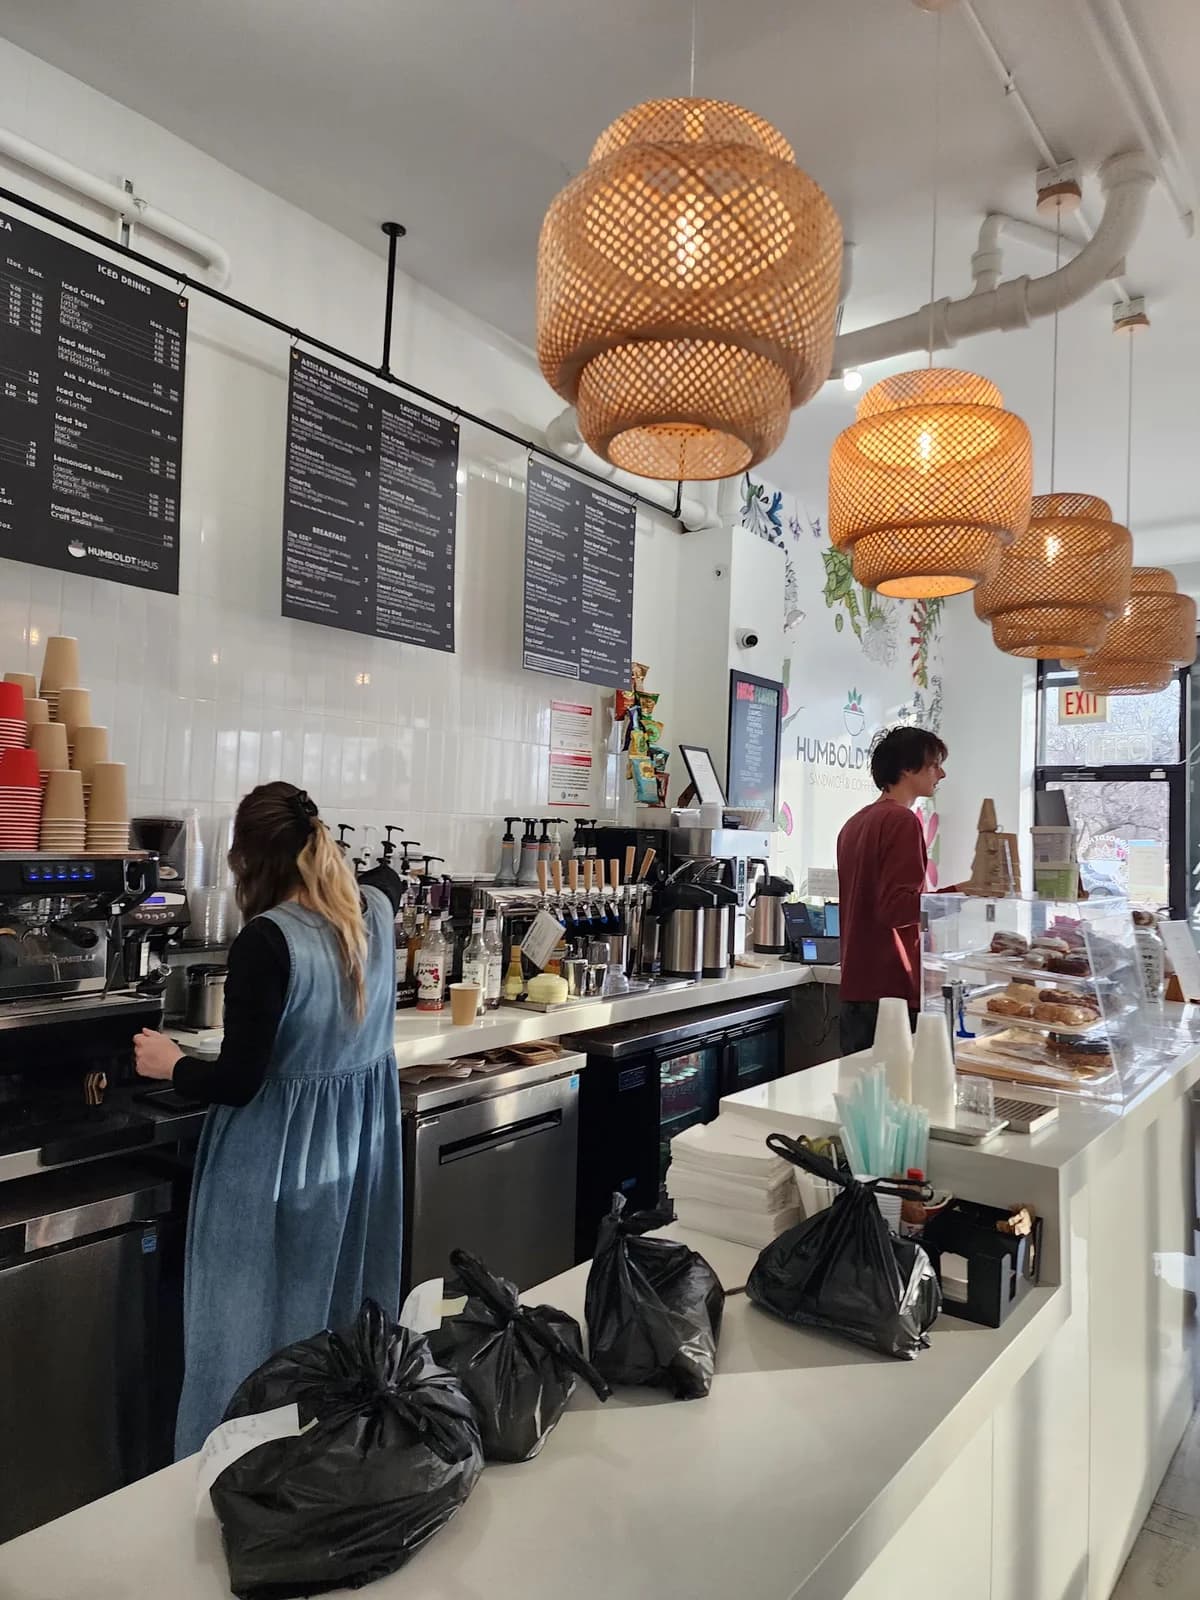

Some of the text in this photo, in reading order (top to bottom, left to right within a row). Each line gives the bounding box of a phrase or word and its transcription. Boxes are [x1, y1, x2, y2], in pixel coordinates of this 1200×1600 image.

[98, 264, 151, 295] ICED DRINKS
[62, 281, 106, 305] Iced Coffee
[58, 336, 106, 360] Iced Matcha
[64, 371, 76, 380] Ask
[88, 380, 108, 392] About
[108, 388, 120, 396] Our
[330, 371, 368, 394] SANDWICHES
[56, 386, 92, 404] Iced Chai
[55, 412, 88, 429] Iced Tea
[54, 454, 92, 472] Lemonade
[94, 466, 124, 480] Shakers
[50, 510, 70, 521] Craft
[51, 504, 104, 522] Fountain Drinks
[312, 526, 347, 542] BREAKFAST
[1066, 691, 1096, 714] EXIT
